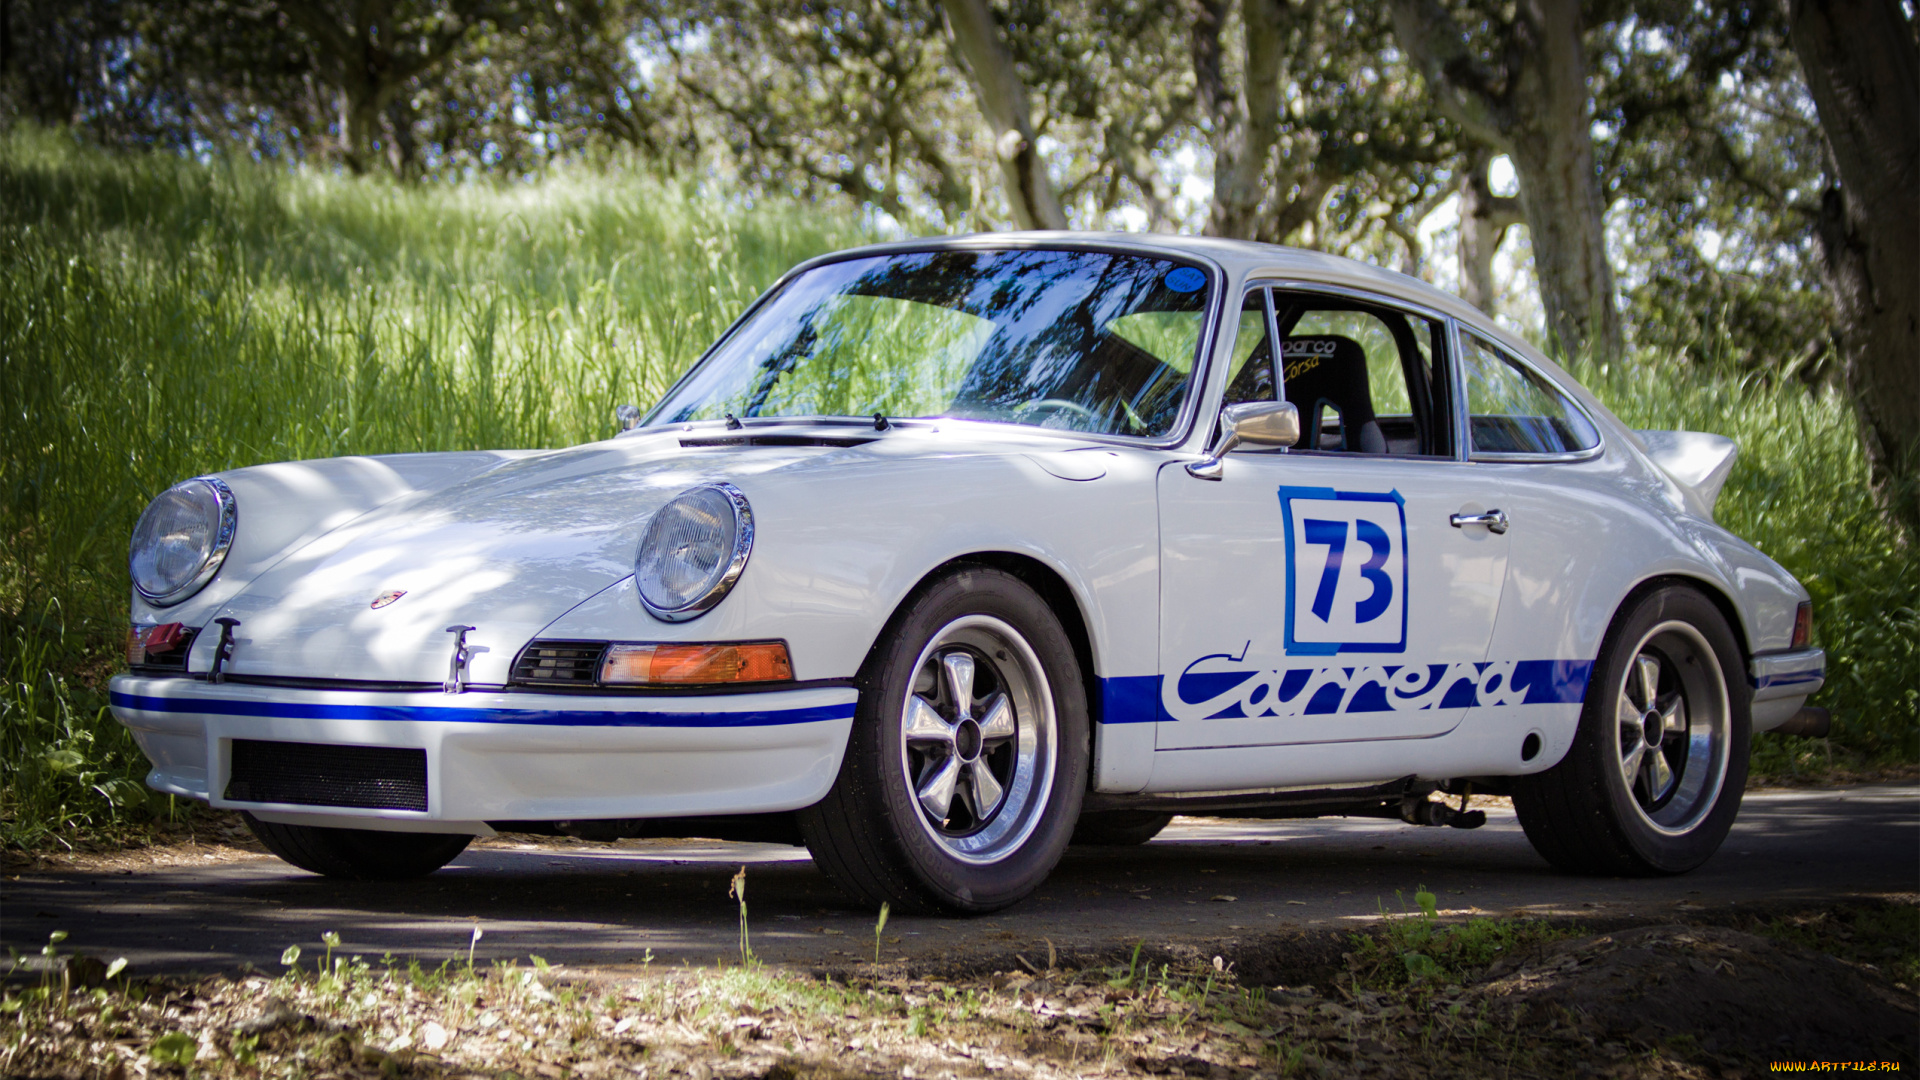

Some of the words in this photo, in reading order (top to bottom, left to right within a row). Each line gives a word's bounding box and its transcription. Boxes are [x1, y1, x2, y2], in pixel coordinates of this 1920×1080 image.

[1179, 268, 1204, 282] SAT
[1167, 276, 1192, 290] SUN
[1281, 340, 1337, 354] parco
[1303, 518, 1394, 624] 73
[1160, 640, 1532, 722] Carrera
